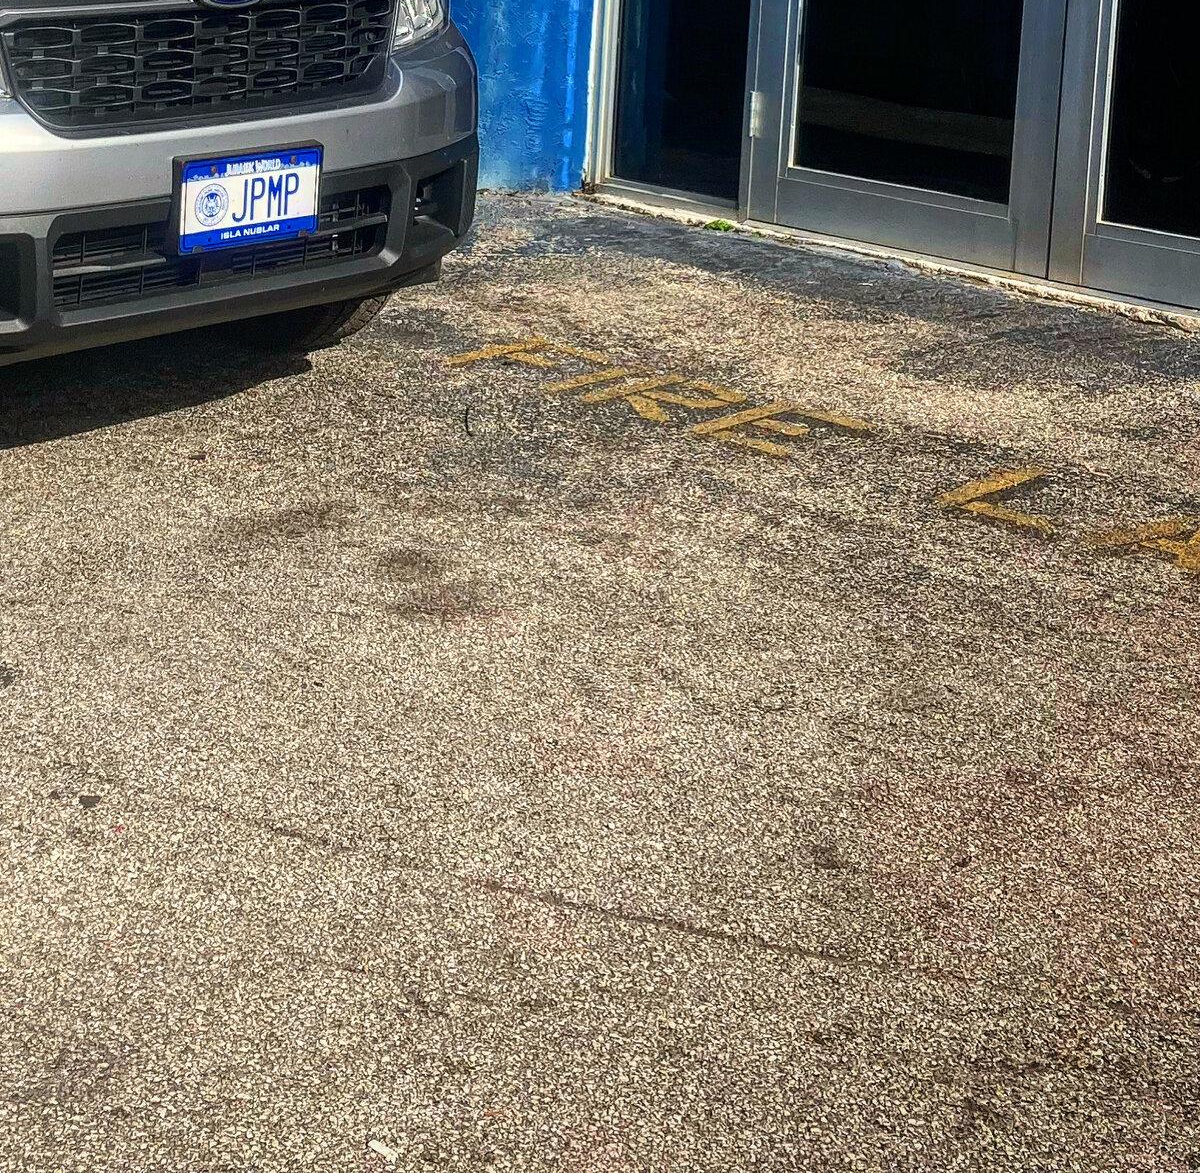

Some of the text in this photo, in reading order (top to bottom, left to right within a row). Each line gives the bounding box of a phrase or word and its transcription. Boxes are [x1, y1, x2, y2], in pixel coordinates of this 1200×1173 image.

[232, 172, 300, 223] JPMP
[220, 224, 281, 240] ISLA NUBLAR
[448, 336, 877, 459] FIRE
